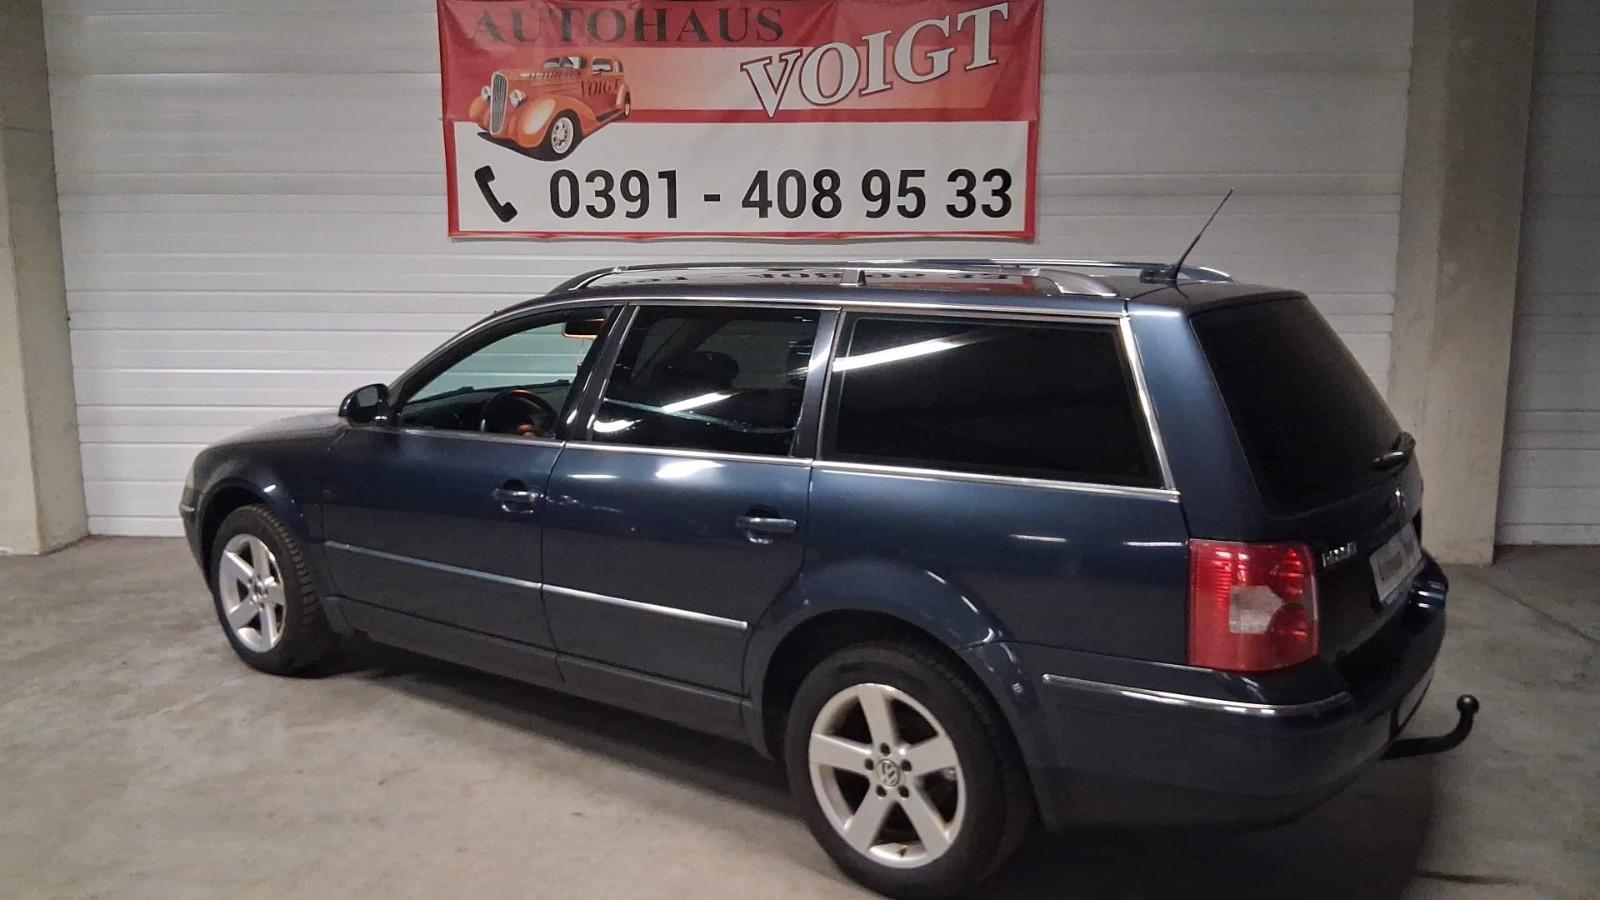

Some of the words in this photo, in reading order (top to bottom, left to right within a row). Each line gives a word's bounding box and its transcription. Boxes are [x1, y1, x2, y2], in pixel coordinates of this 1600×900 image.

[471, 7, 784, 43] AUTOHAUS
[740, 2, 1009, 119] VOIGT
[580, 78, 621, 98] VOIGT
[549, 168, 678, 219] 0391
[703, 193, 721, 202] -
[741, 169, 842, 219] 408
[861, 169, 926, 219] 95
[945, 168, 1012, 219] 33
